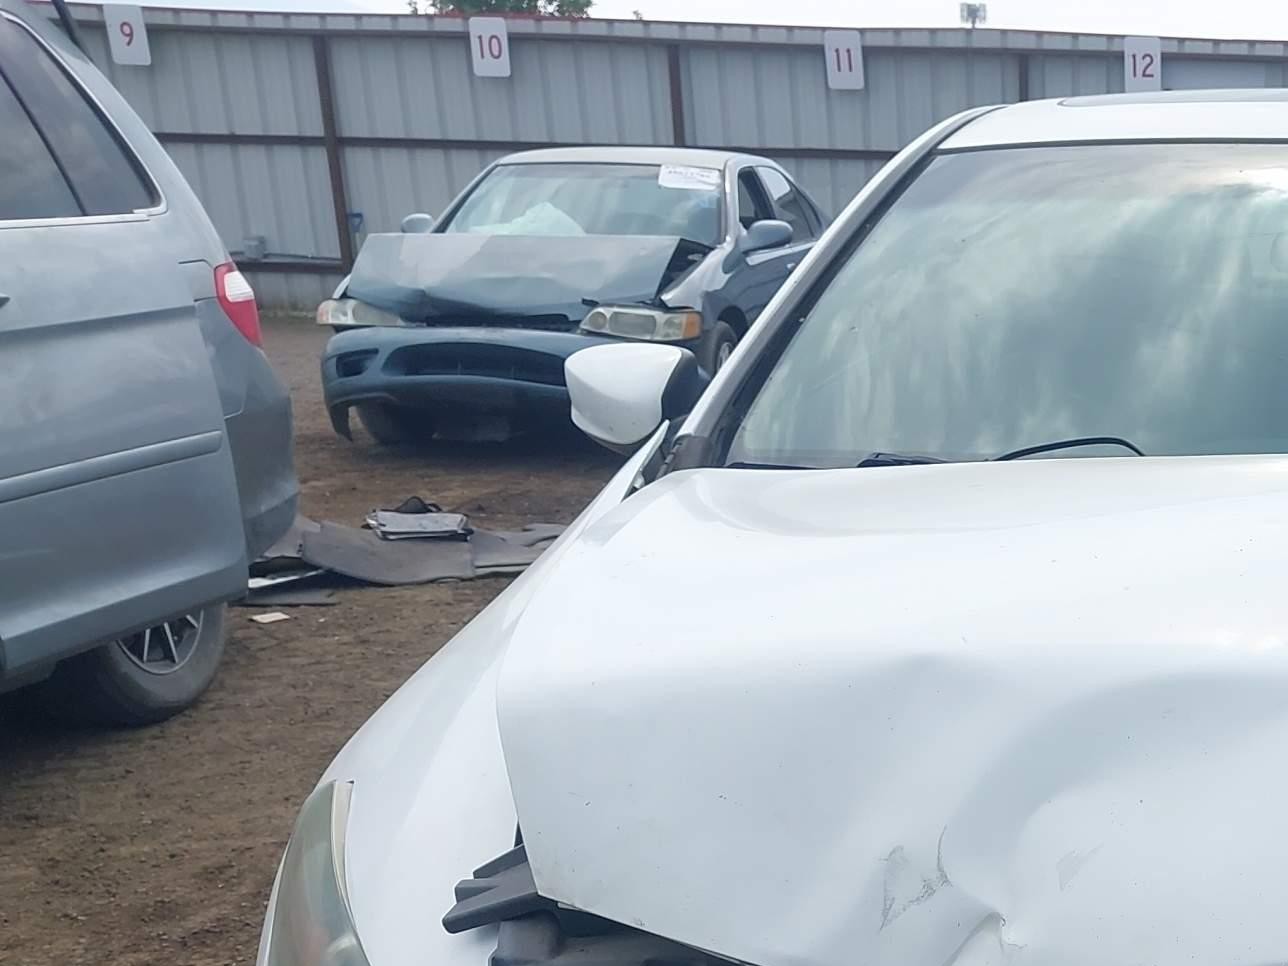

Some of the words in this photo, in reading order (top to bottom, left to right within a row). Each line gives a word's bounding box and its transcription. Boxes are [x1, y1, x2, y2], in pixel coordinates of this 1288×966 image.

[119, 22, 134, 46] 9
[478, 35, 502, 60] 10
[835, 47, 853, 73] 11
[1131, 53, 1155, 79] 12
